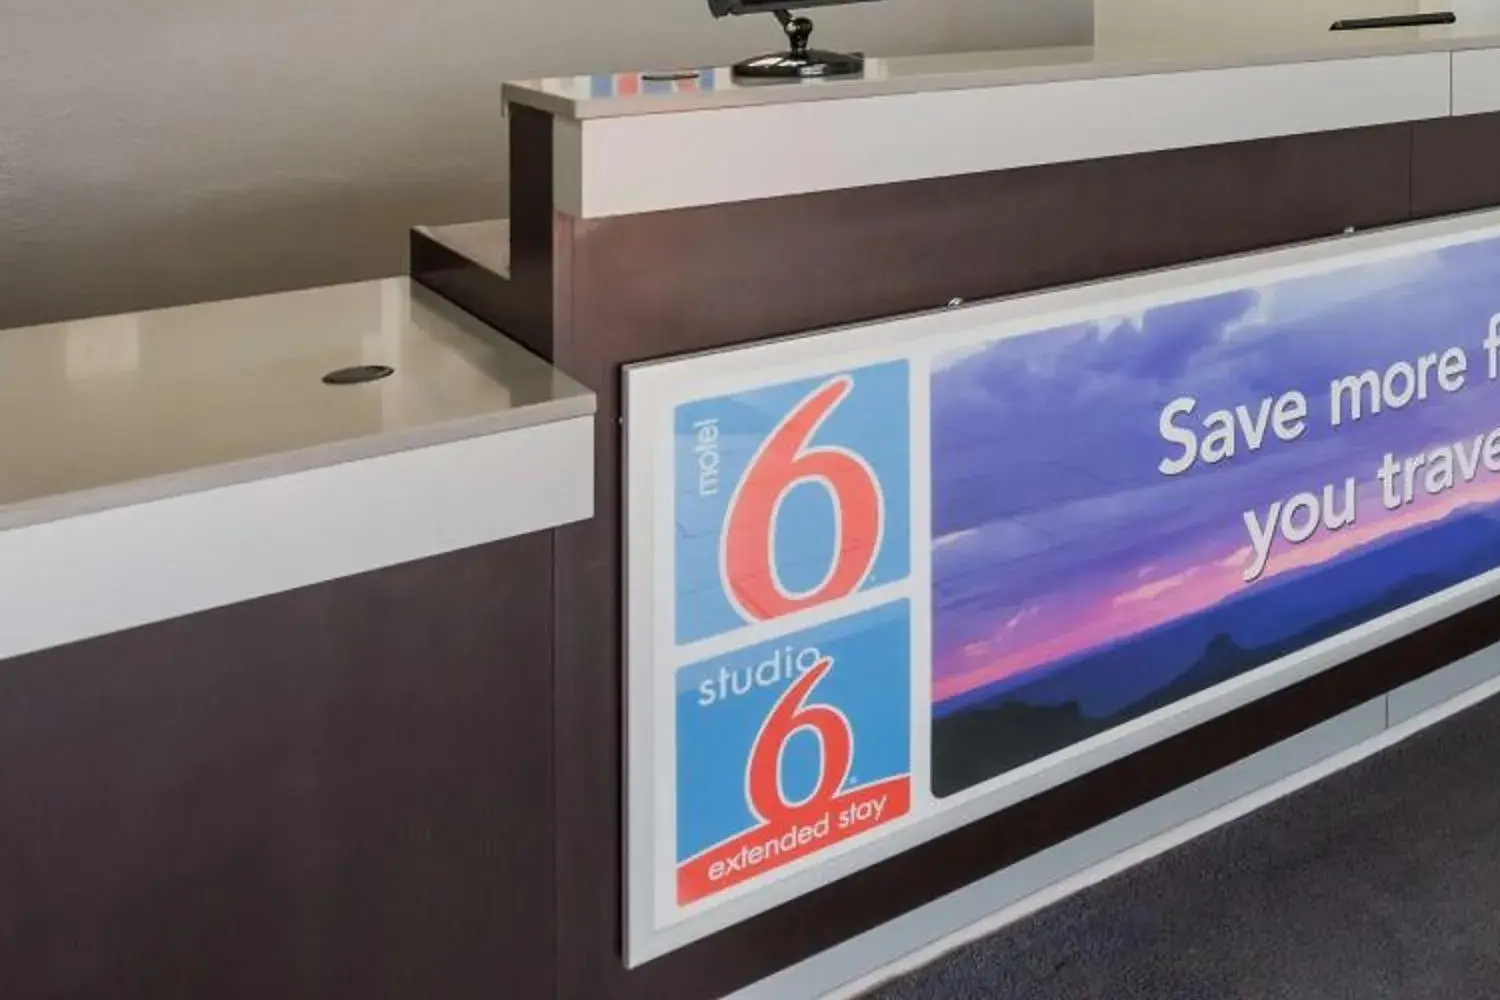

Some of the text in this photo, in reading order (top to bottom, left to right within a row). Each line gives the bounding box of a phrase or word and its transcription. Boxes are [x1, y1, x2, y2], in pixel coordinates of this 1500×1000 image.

[693, 417, 720, 496] motel
[1158, 390, 1307, 477] Save
[1330, 346, 1466, 427] more
[719, 374, 886, 624] 6
[1243, 475, 1355, 582] you
[697, 646, 821, 706] studio
[744, 655, 854, 826] 6
[707, 794, 888, 881] extended stay
